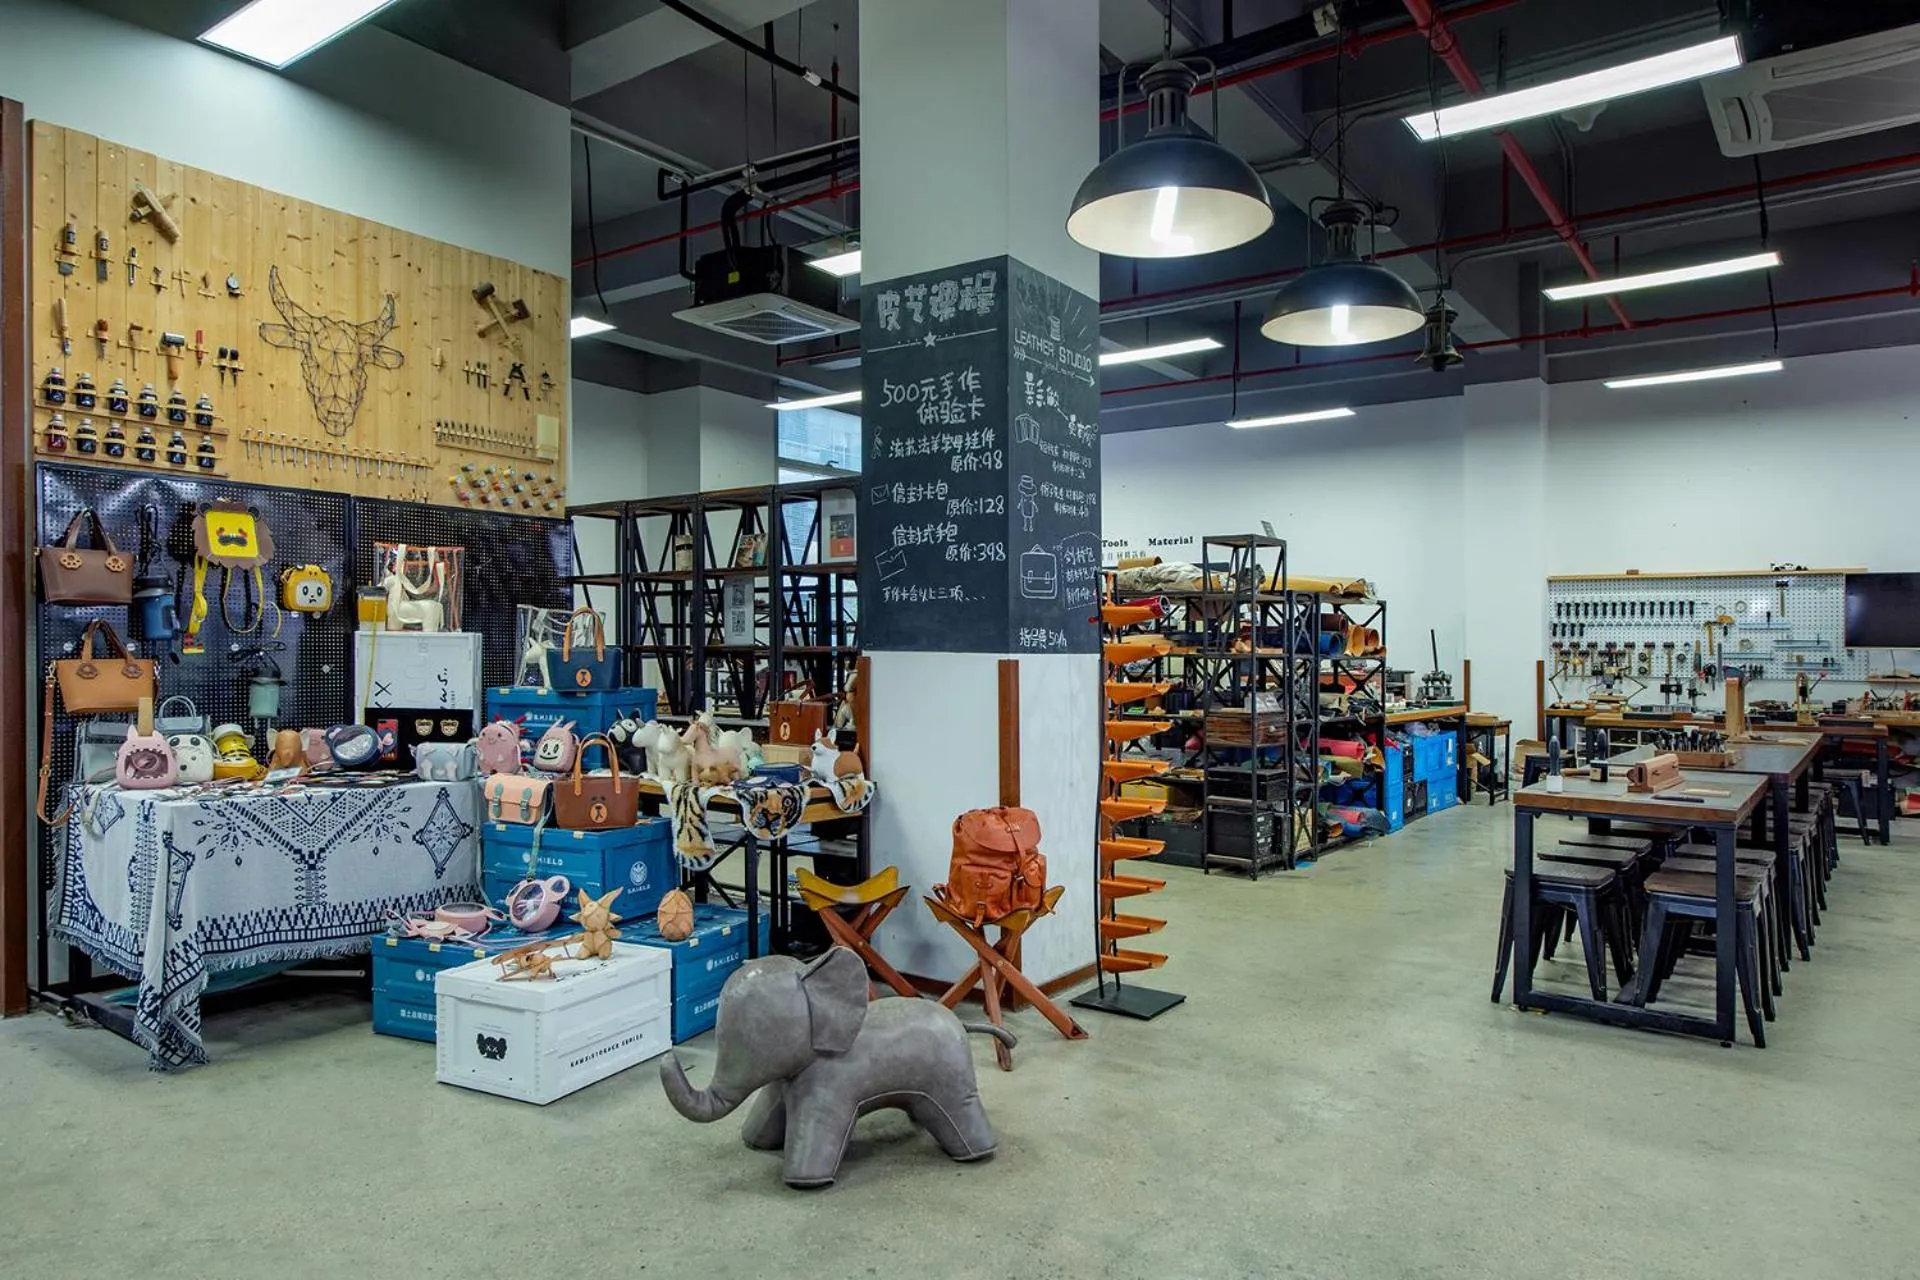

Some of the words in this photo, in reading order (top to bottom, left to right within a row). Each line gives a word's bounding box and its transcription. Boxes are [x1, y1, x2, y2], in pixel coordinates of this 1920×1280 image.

[1059, 346, 1093, 373] STUDIO
[880, 366, 982, 407] 500元手作
[917, 395, 985, 426] 体验卡
[892, 479, 949, 504] 信封卡包
[892, 521, 958, 546] 信封式手包
[1148, 536, 1193, 546] Material
